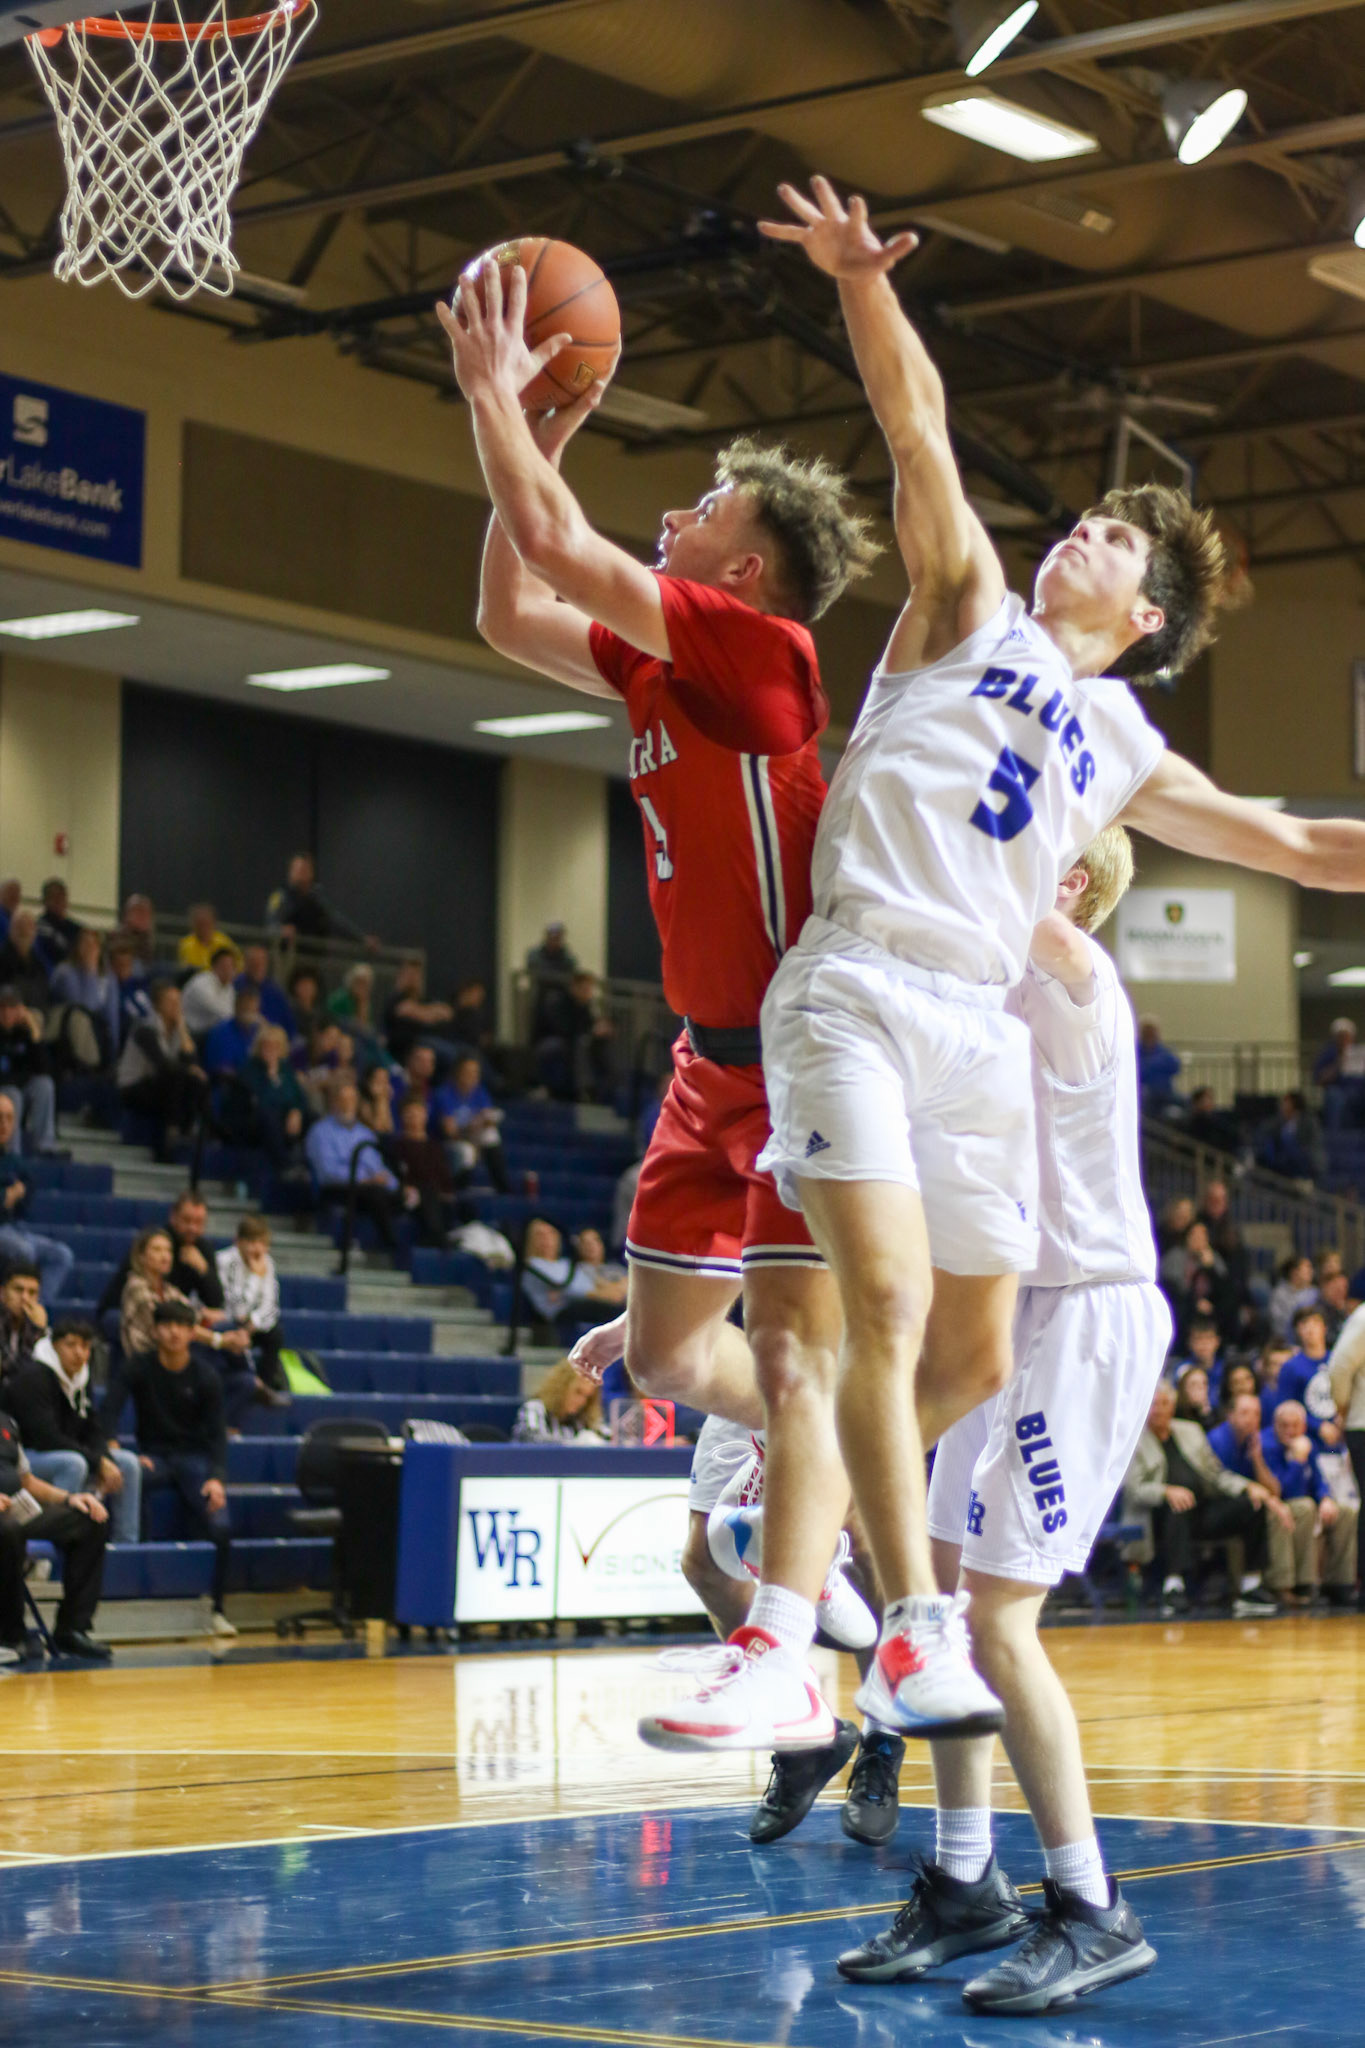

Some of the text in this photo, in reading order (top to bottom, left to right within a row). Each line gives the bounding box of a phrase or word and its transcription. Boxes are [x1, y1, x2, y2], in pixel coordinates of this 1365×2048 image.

[969, 667, 1096, 797] BLUES
[969, 745, 1042, 842] 5
[1015, 1410, 1068, 1534] BLUES
[467, 1508, 543, 1587] WR
